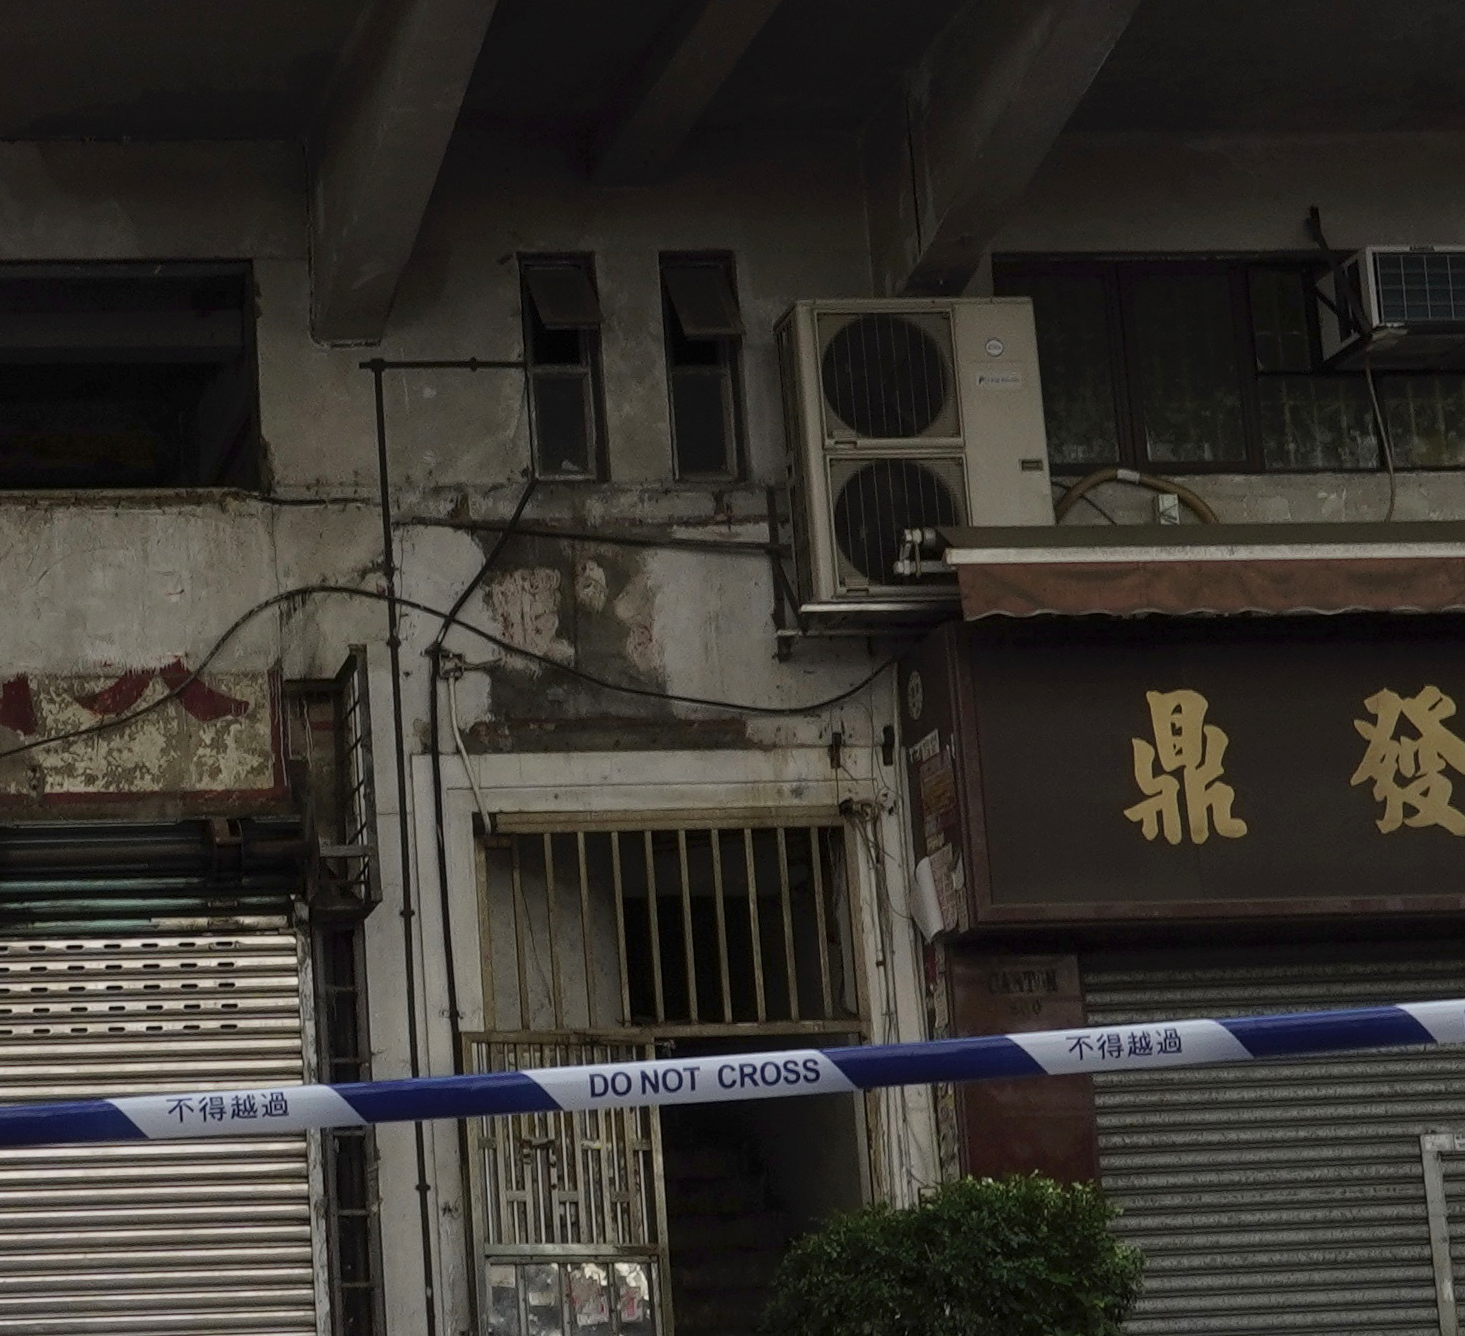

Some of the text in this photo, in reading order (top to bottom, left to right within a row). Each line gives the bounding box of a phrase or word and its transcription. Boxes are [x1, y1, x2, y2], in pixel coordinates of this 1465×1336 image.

[1065, 1028, 1183, 1061] 不得越過
[588, 1059, 821, 1099] DO NOT CROSS
[167, 1092, 290, 1123] 不得越過
